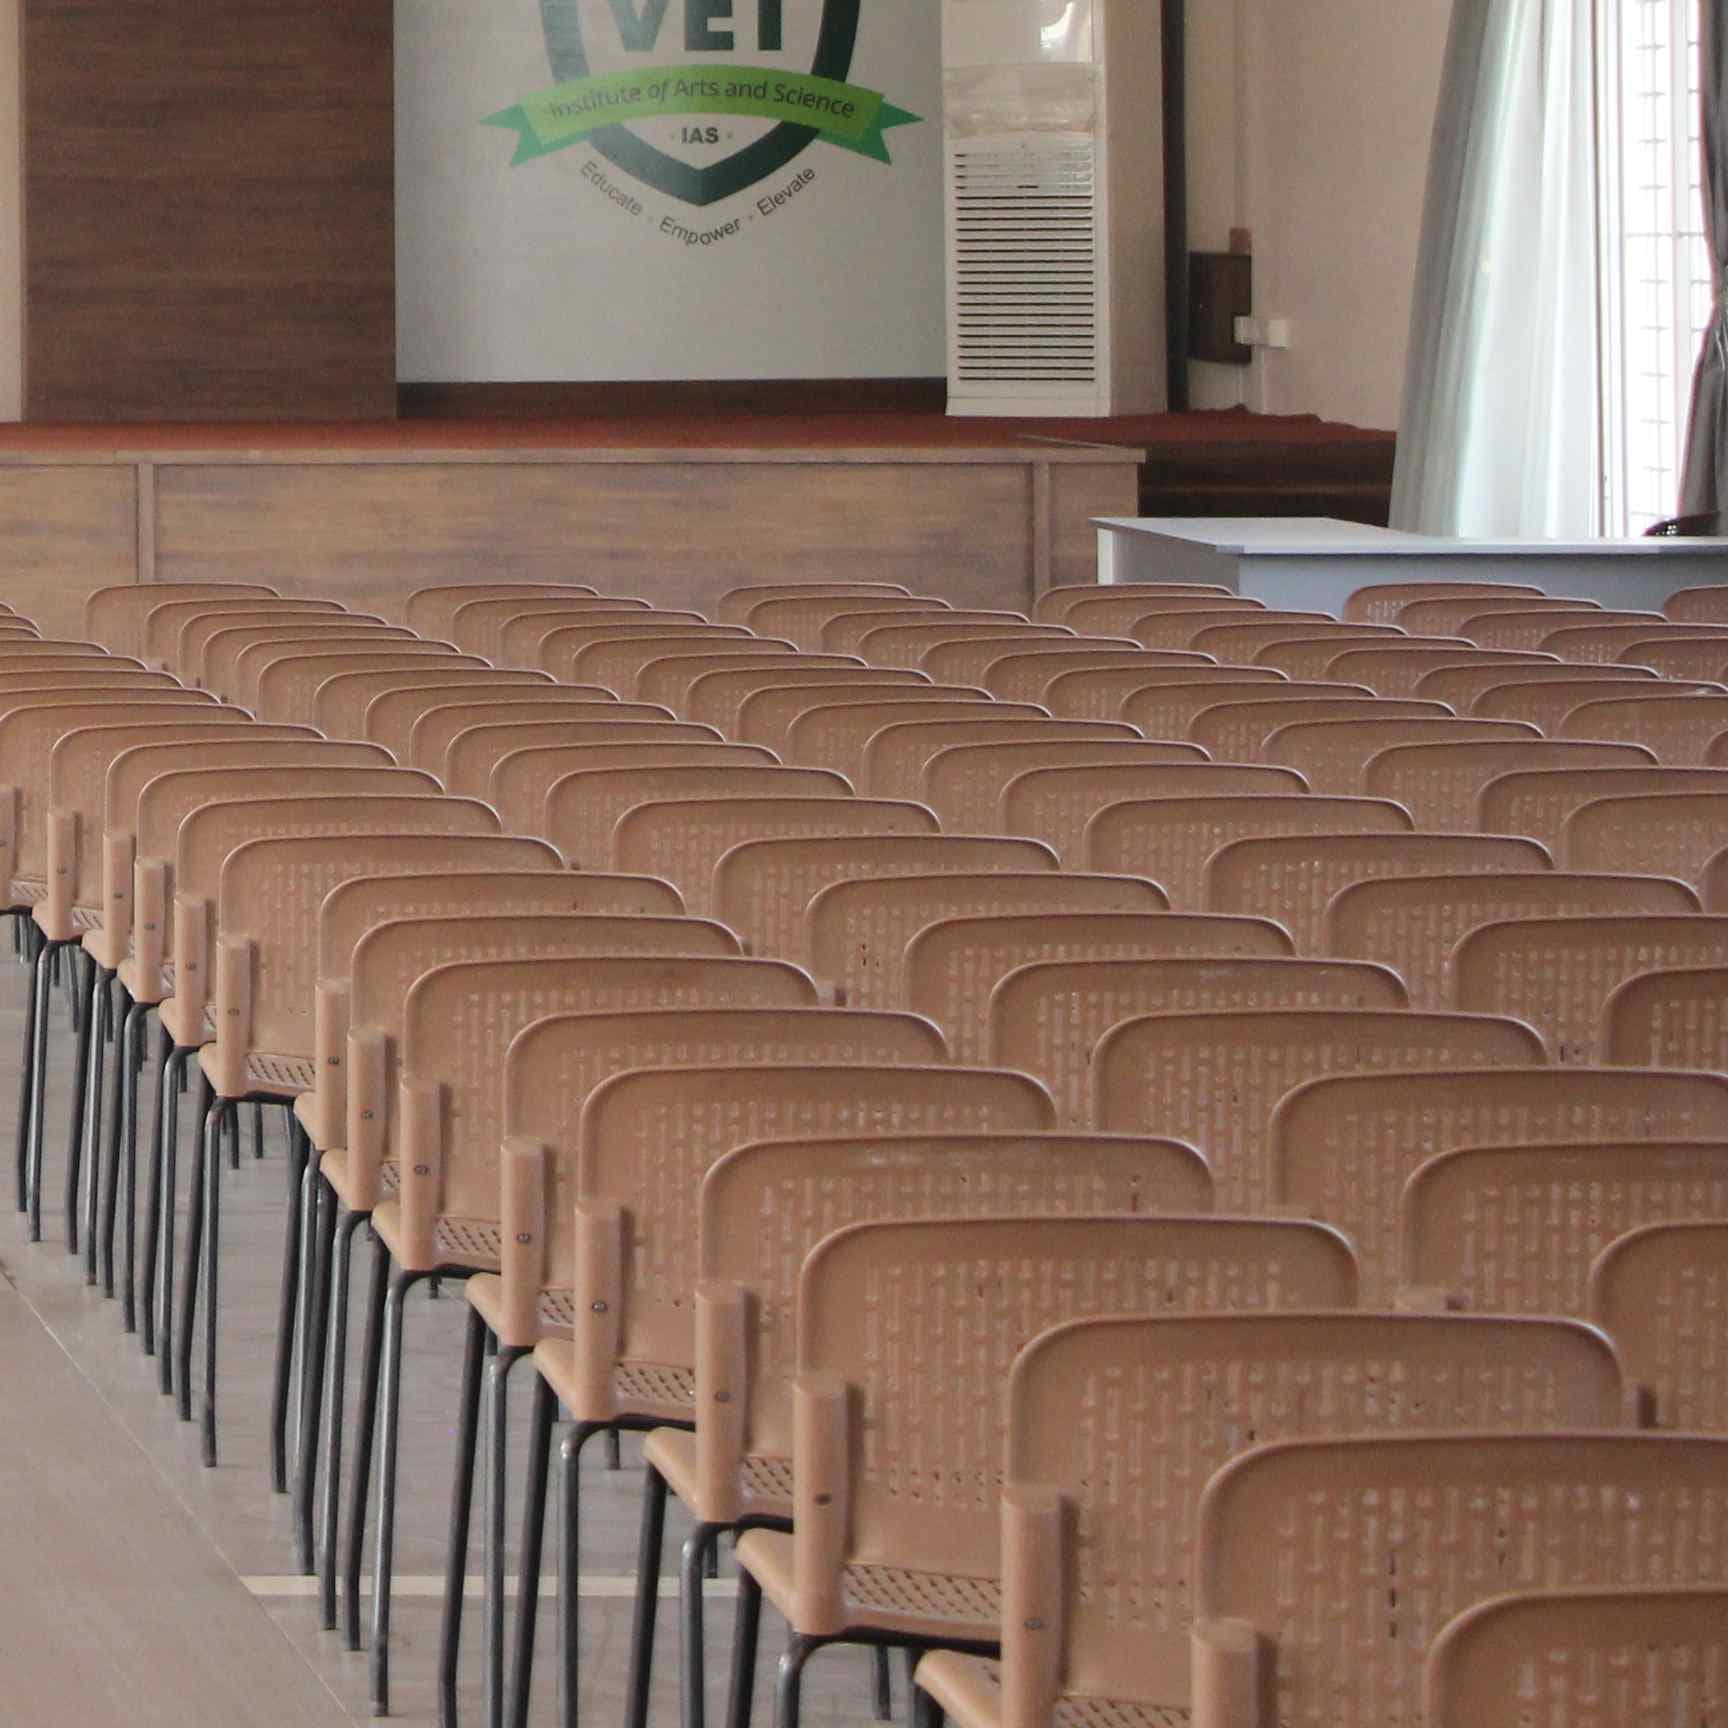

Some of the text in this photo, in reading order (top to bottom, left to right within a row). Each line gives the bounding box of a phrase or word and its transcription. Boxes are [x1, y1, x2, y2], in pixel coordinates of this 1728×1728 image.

[550, 77, 856, 120] Institute of Arts and Science
[680, 126, 720, 145] IAS
[579, 161, 816, 246] Educate Empower Elevate
